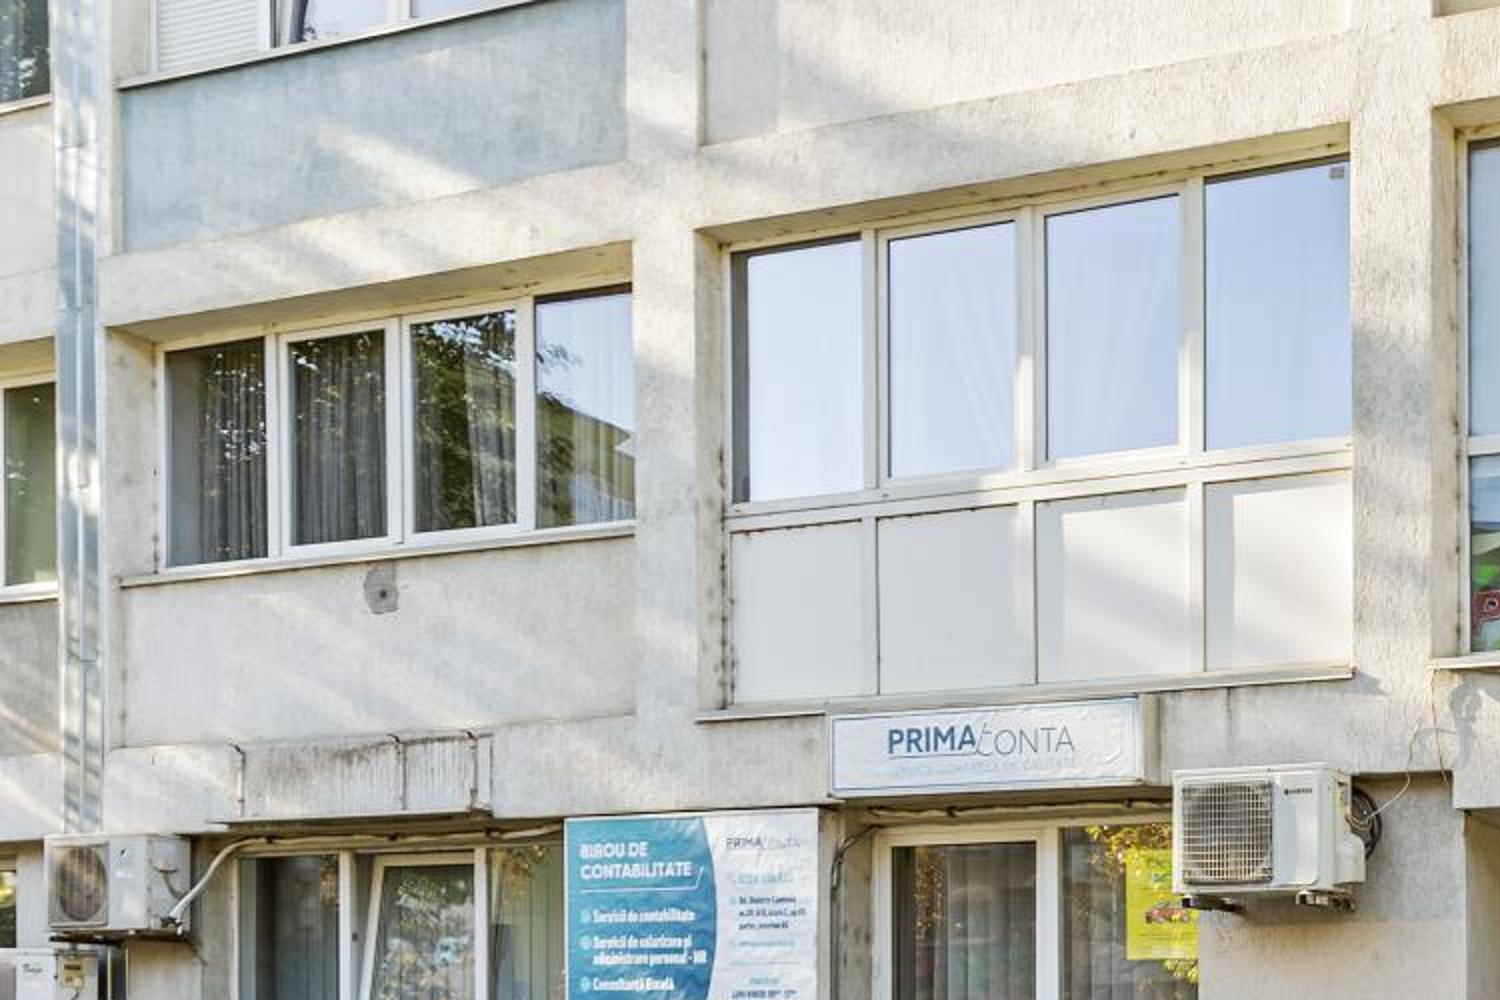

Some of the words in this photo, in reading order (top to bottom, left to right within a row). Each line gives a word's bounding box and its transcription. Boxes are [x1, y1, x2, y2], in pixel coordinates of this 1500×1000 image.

[580, 842, 626, 857] BIROU
[628, 841, 649, 857] DE
[580, 861, 693, 879] CONTABILITATE
